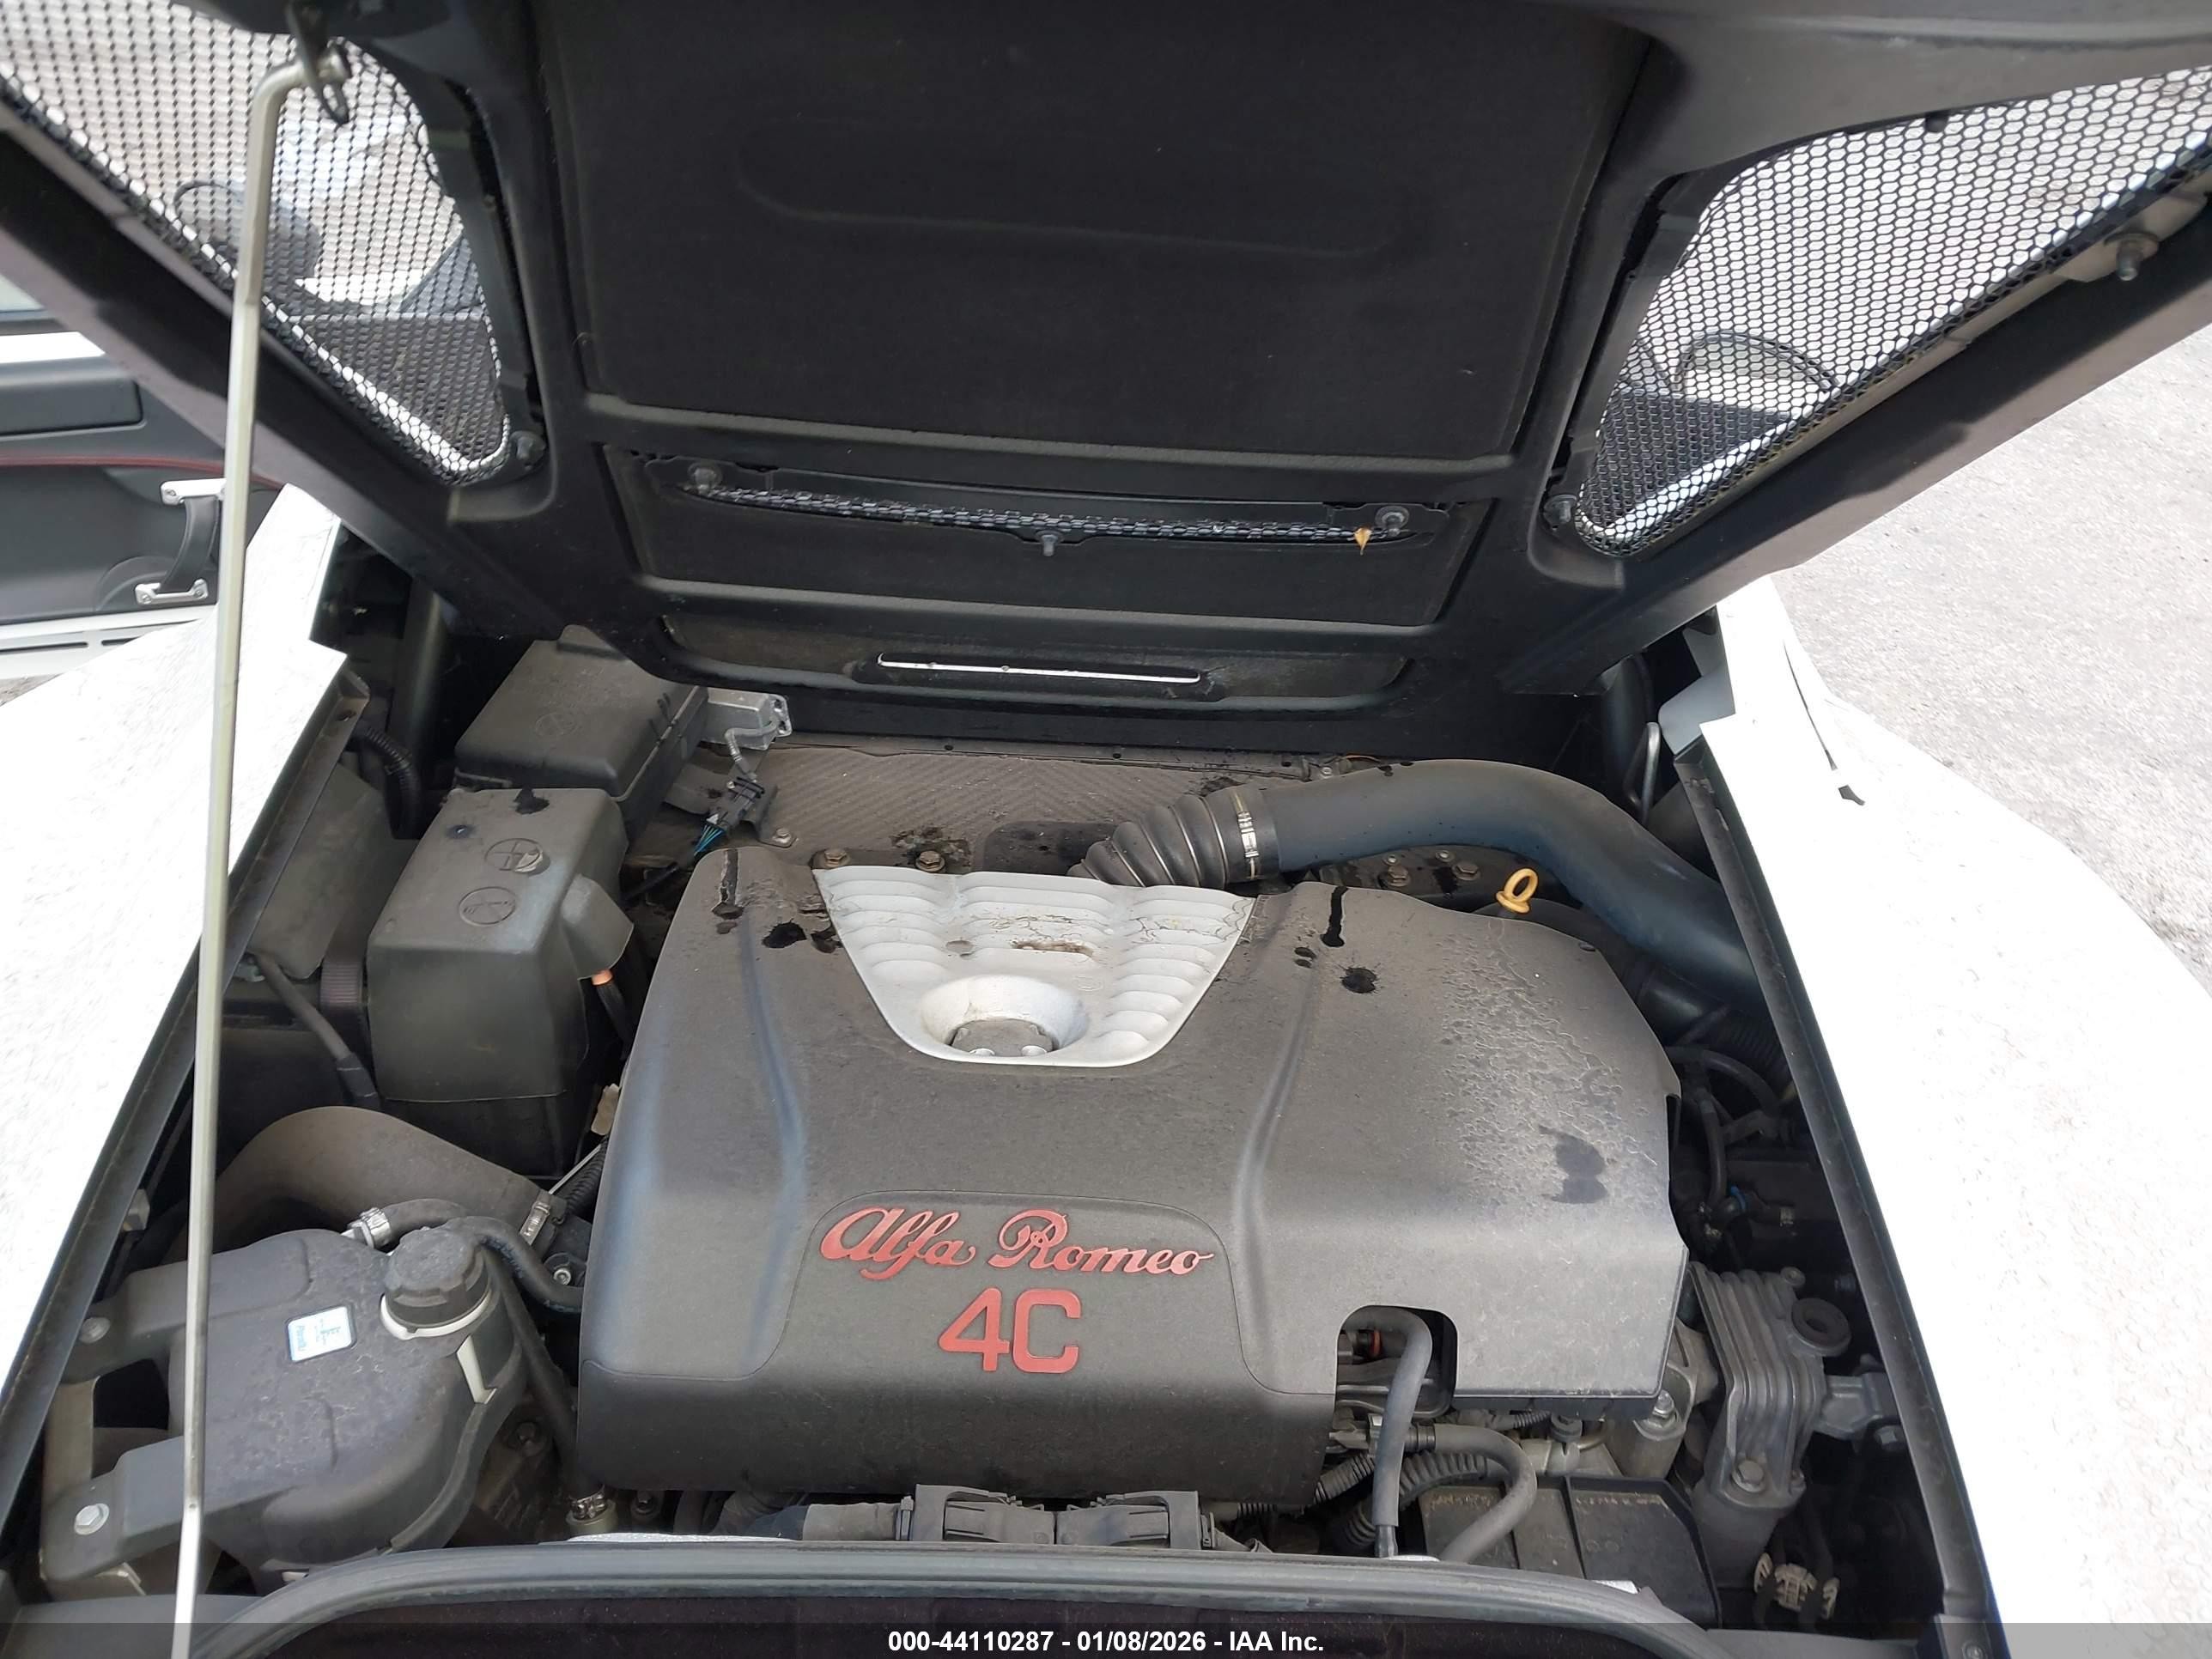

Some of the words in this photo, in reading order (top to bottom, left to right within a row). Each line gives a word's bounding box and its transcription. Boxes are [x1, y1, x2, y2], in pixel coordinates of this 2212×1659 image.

[820, 1206, 976, 1280] Alfa
[987, 1208, 1215, 1275] Romeo
[939, 1287, 1082, 1374] 4C
